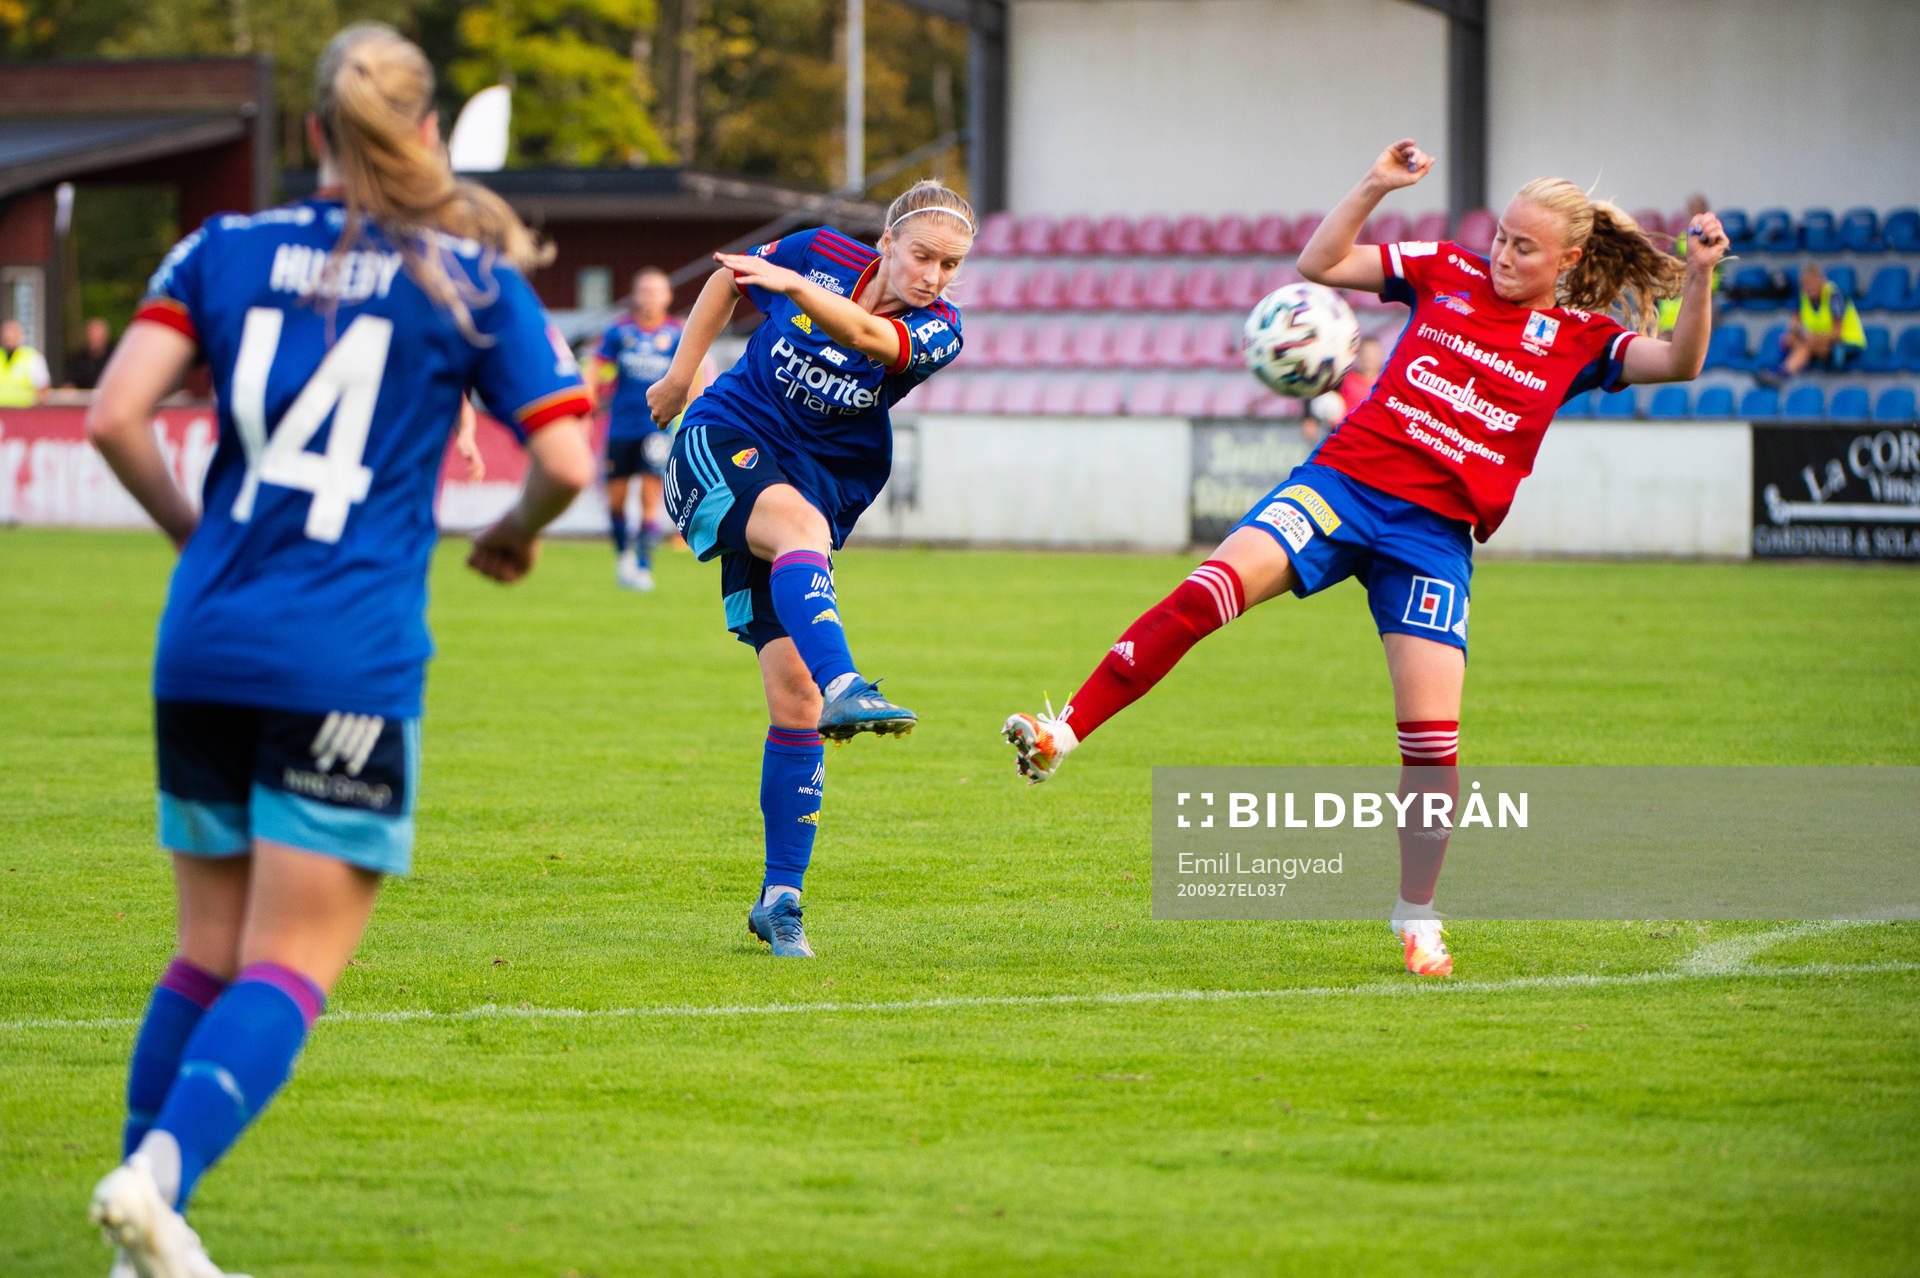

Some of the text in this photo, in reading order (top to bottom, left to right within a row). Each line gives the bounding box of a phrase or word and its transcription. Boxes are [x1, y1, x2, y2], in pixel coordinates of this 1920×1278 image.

[809, 268, 840, 286] NORDIC
[818, 346, 849, 367] ABT
[1417, 322, 1547, 392] #mitthässleholm
[1405, 355, 1522, 432] Emmaljunga
[231, 306, 393, 544] 14
[1386, 395, 1506, 466] Snapphanebygdens
[1405, 421, 1467, 465] Sparbank
[798, 786, 814, 795] NRC
